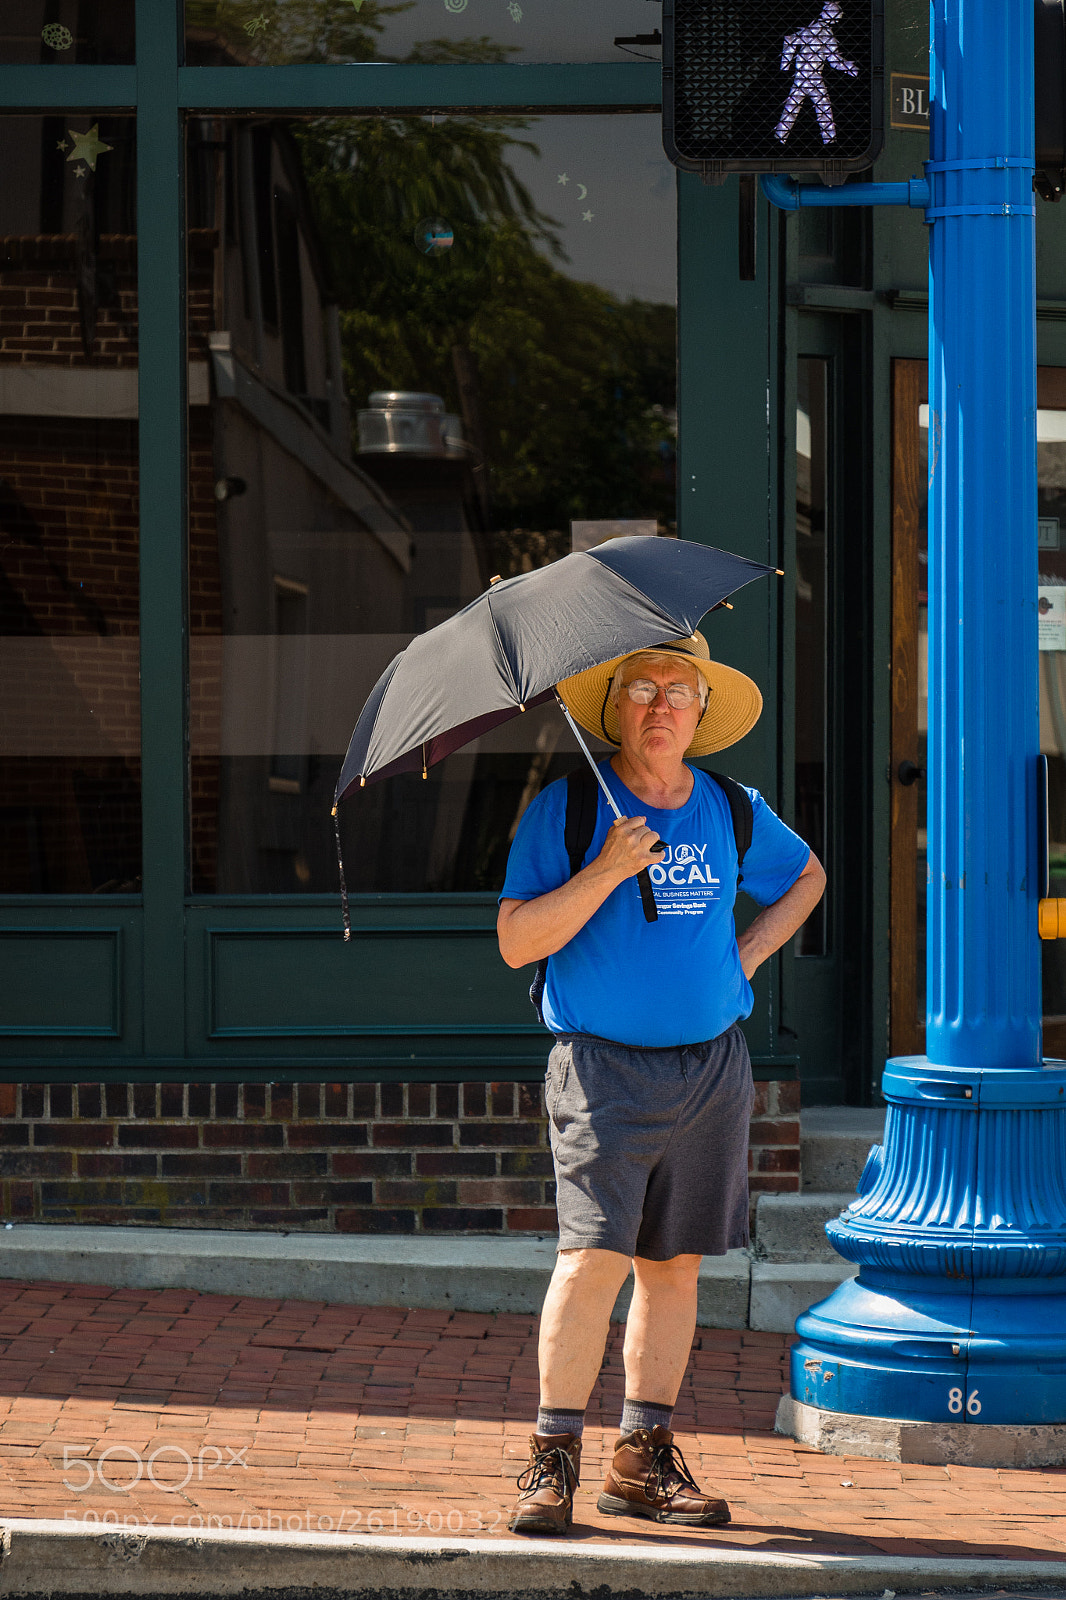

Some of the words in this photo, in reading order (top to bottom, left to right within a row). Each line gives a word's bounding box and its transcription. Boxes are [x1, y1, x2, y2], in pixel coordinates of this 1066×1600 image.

[900, 87, 931, 119] BL
[660, 843, 708, 865] JOY
[648, 864, 720, 885] OCAL
[672, 902, 693, 910] Savings
[948, 1387, 982, 1416] 86
